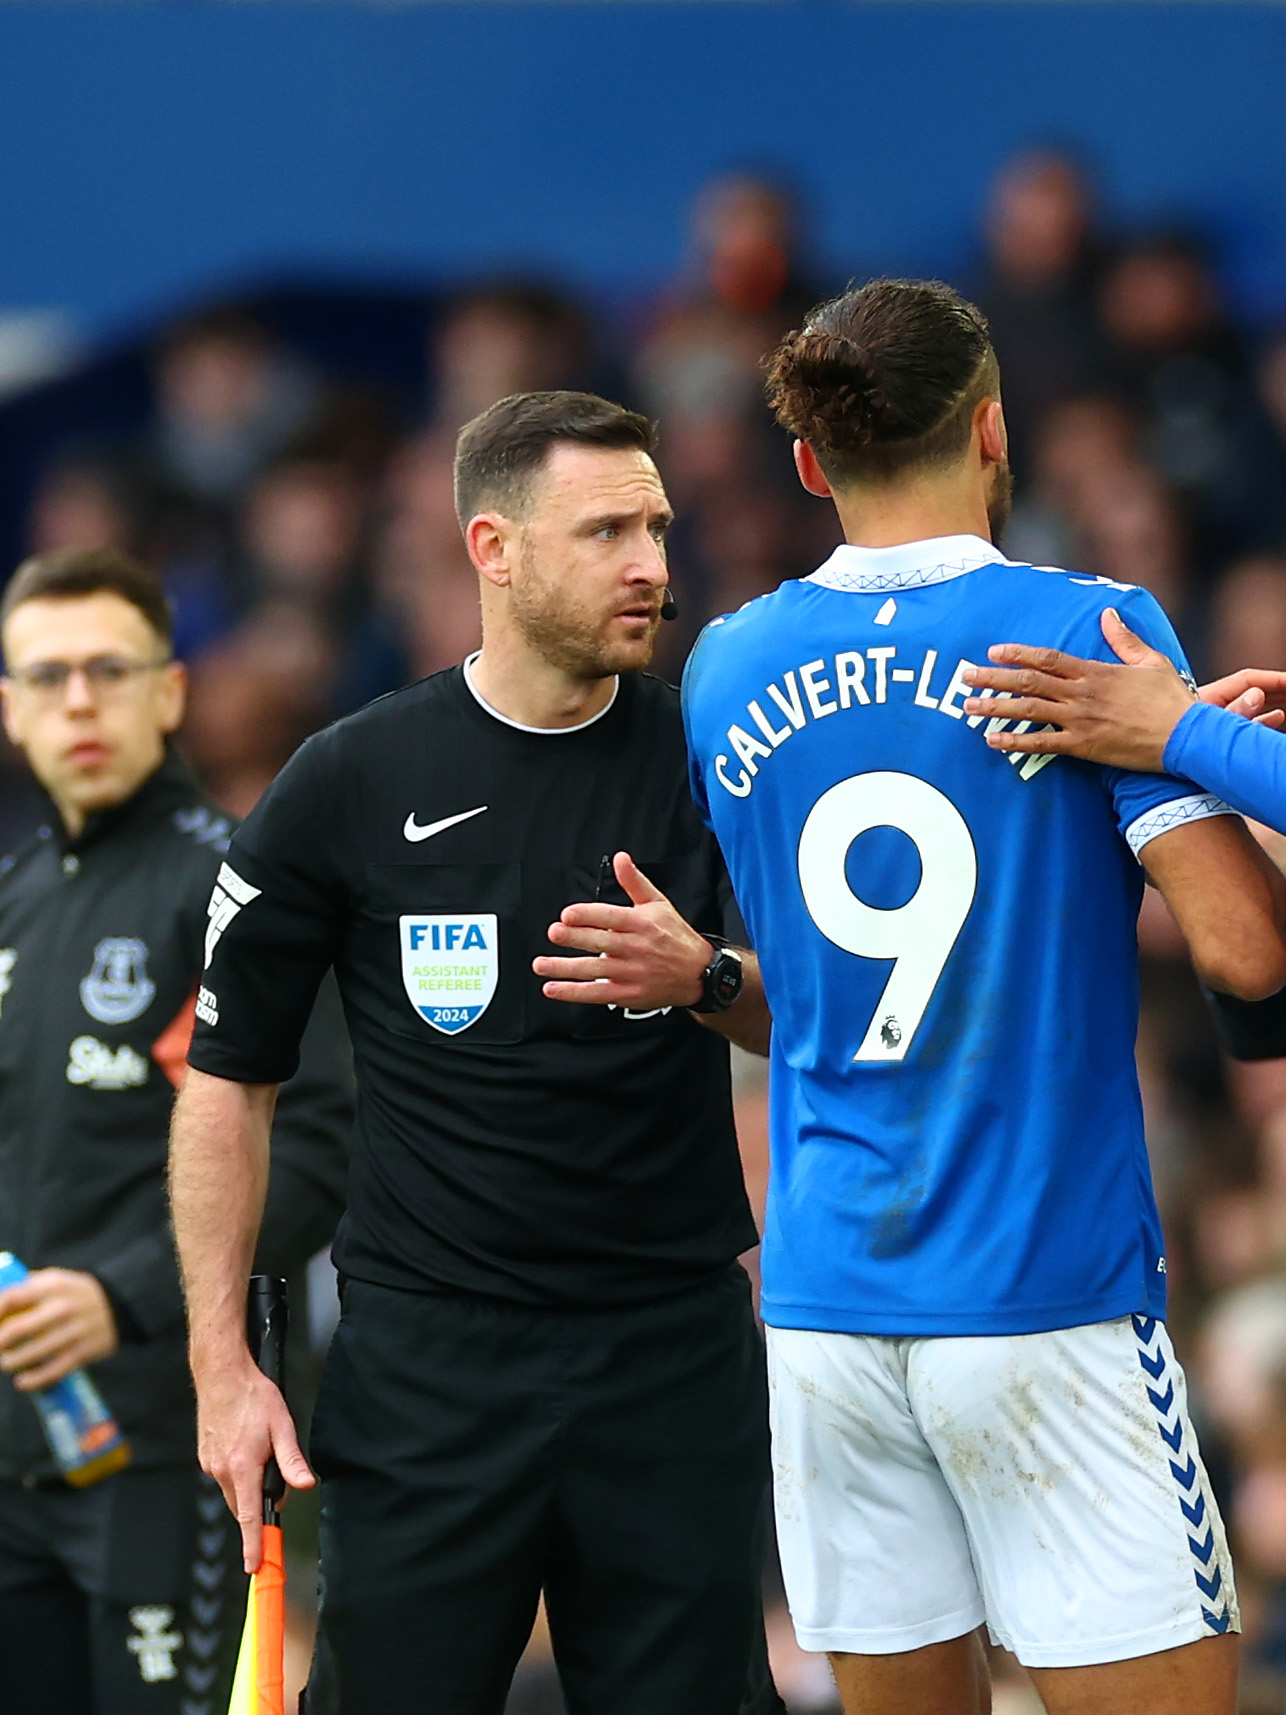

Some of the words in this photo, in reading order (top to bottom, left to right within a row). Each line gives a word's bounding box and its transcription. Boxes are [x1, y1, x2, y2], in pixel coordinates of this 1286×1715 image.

[797, 770, 977, 1062] 9
[410, 924, 488, 951] FIFA
[412, 965, 488, 977] ASSISTANT
[418, 979, 482, 991] REFEREE
[433, 1009, 469, 1023] 2024
